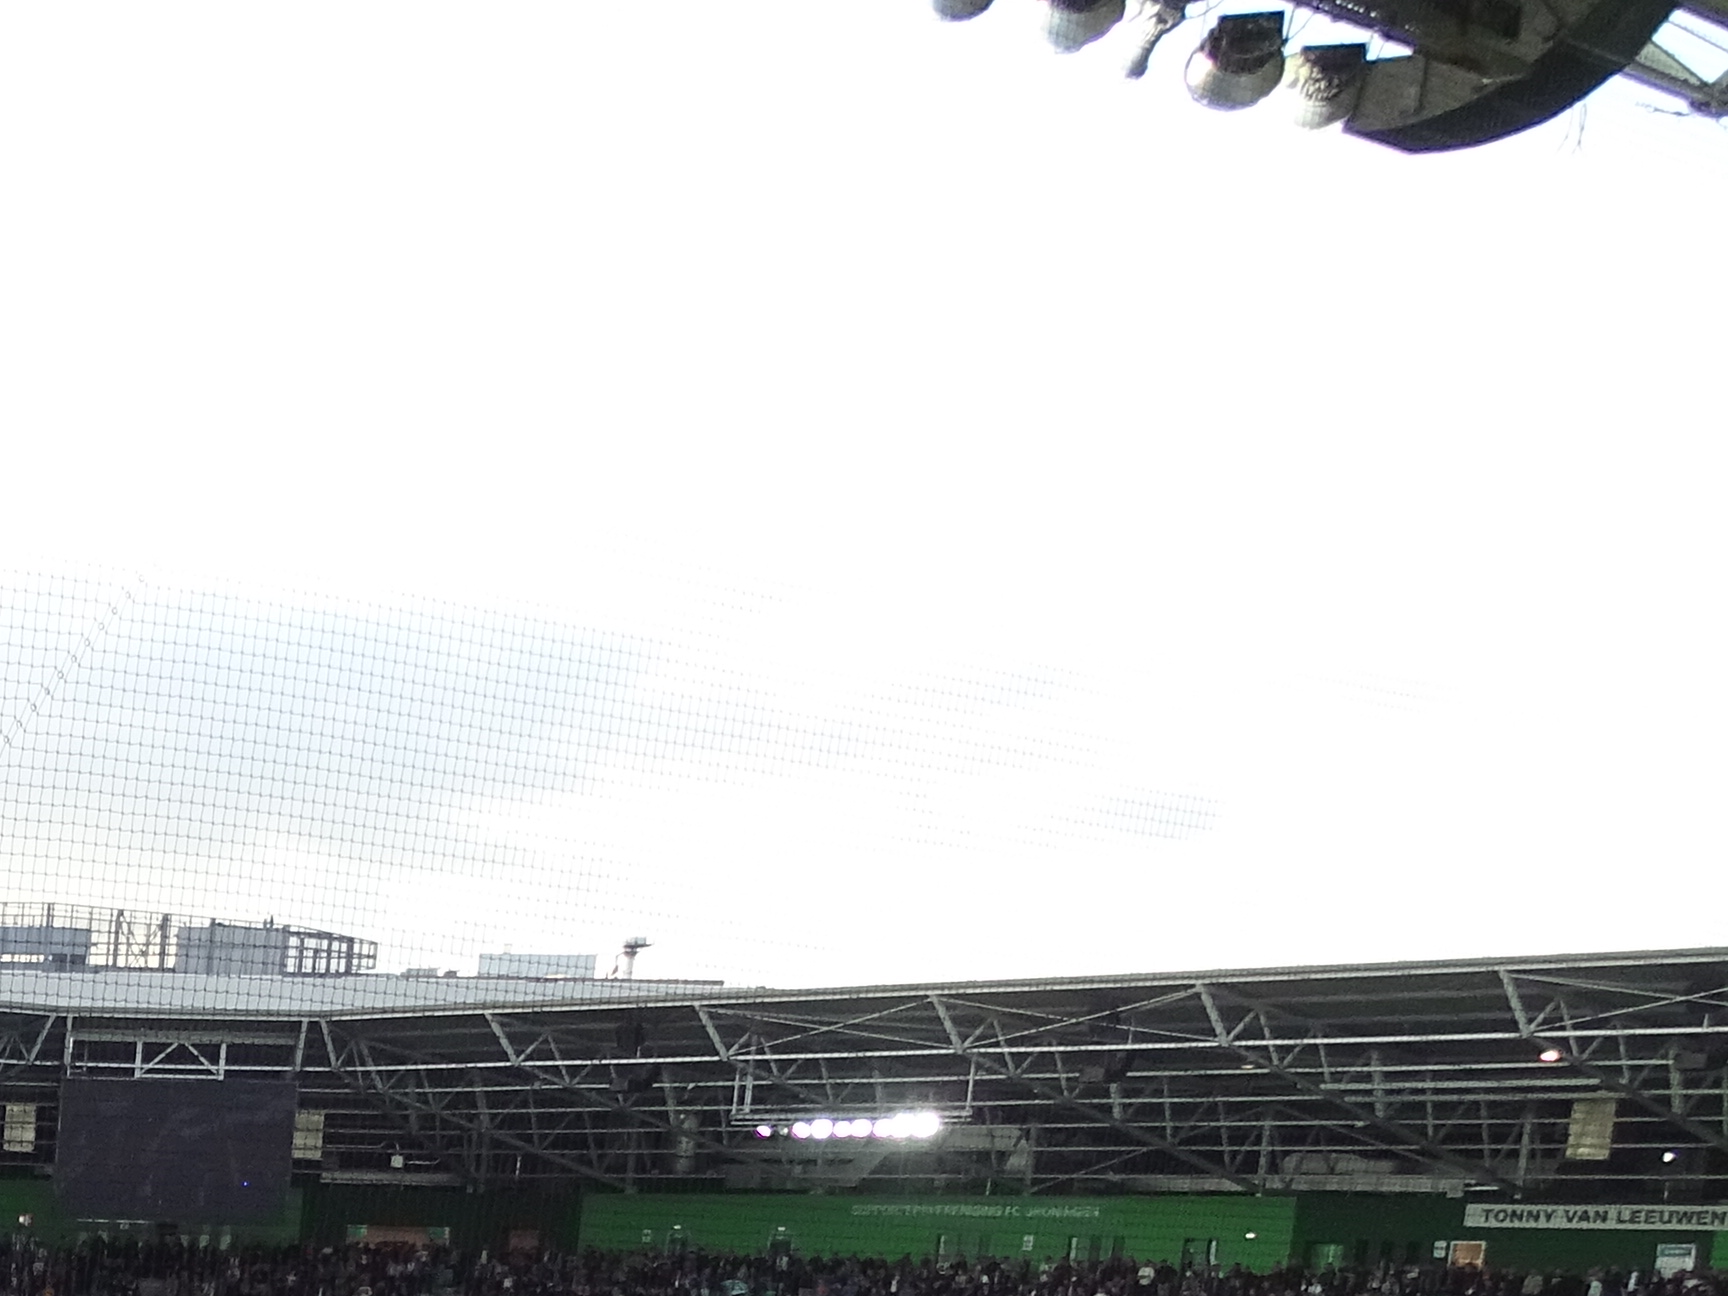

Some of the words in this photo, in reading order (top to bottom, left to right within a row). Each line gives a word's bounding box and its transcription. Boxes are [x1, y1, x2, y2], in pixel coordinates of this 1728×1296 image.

[1481, 1208, 1558, 1224] TONNY
[1563, 1209, 1610, 1225] VAN
[1615, 1209, 1728, 1227] LEEUWEN
